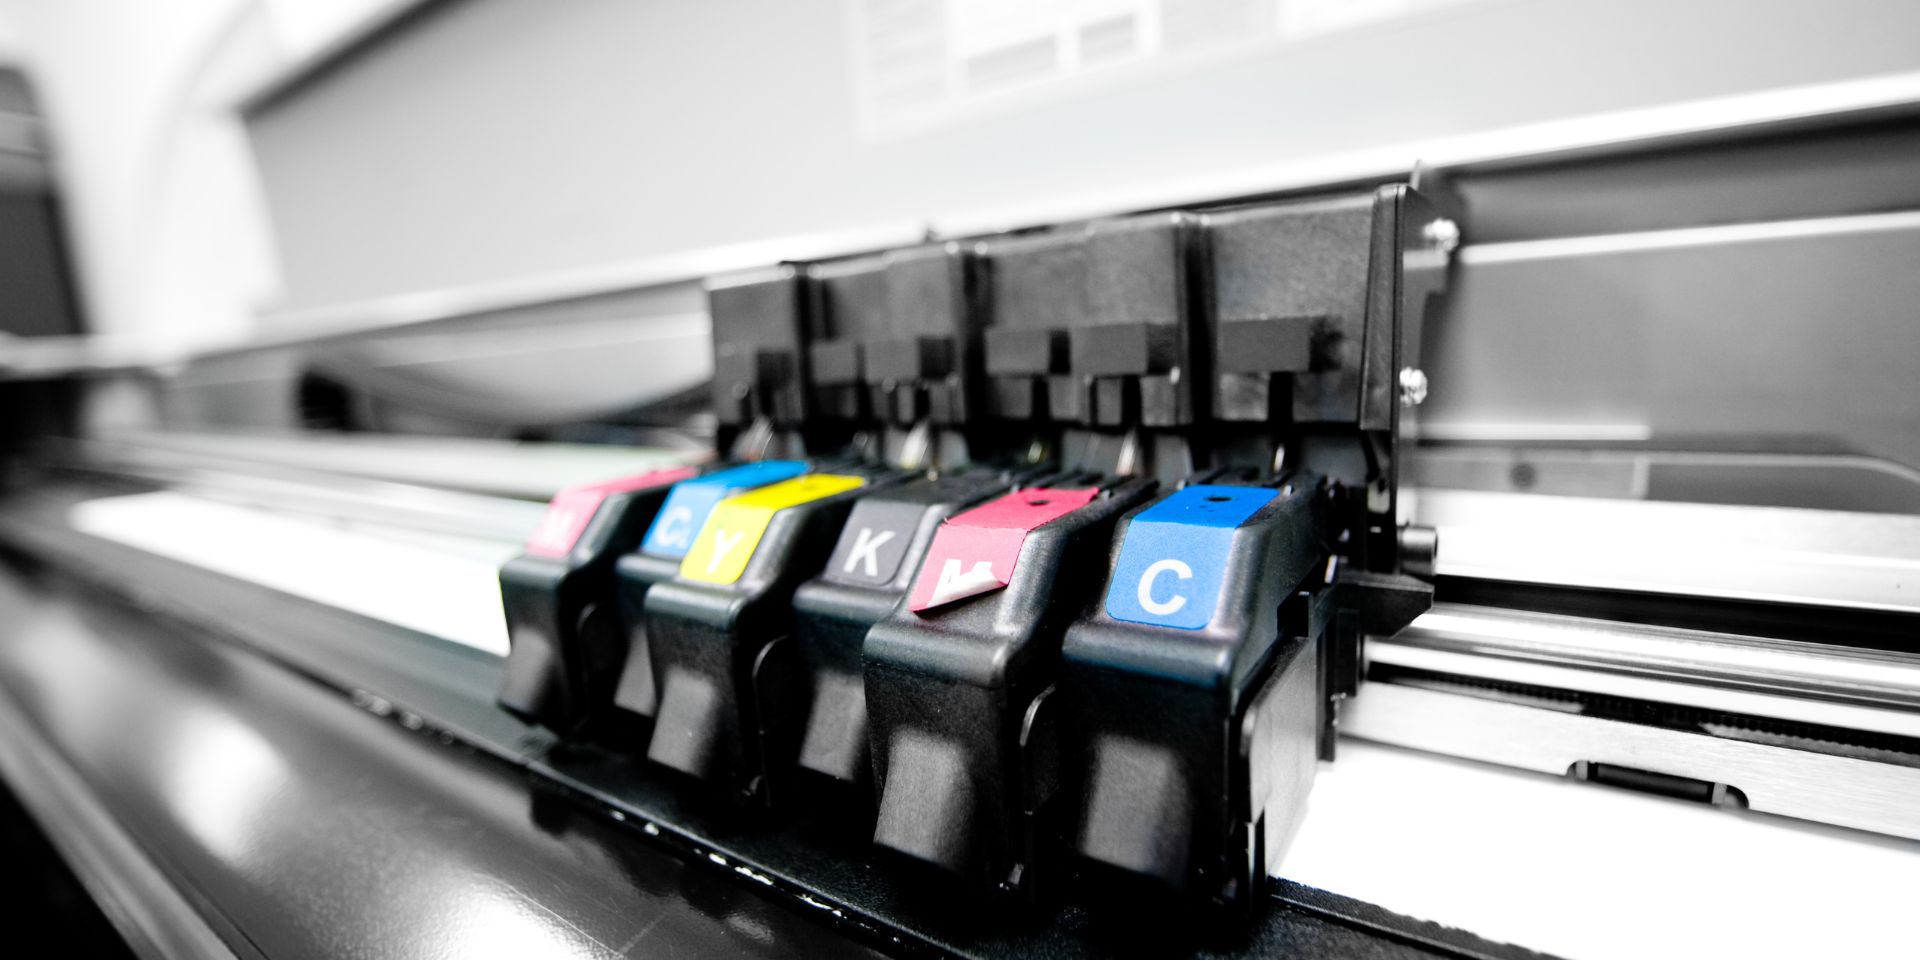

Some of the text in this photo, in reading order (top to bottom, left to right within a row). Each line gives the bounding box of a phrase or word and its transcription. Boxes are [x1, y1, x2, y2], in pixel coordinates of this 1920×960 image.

[707, 529, 745, 574] Y
[843, 527, 896, 577] K
[1138, 559, 1193, 615] C
